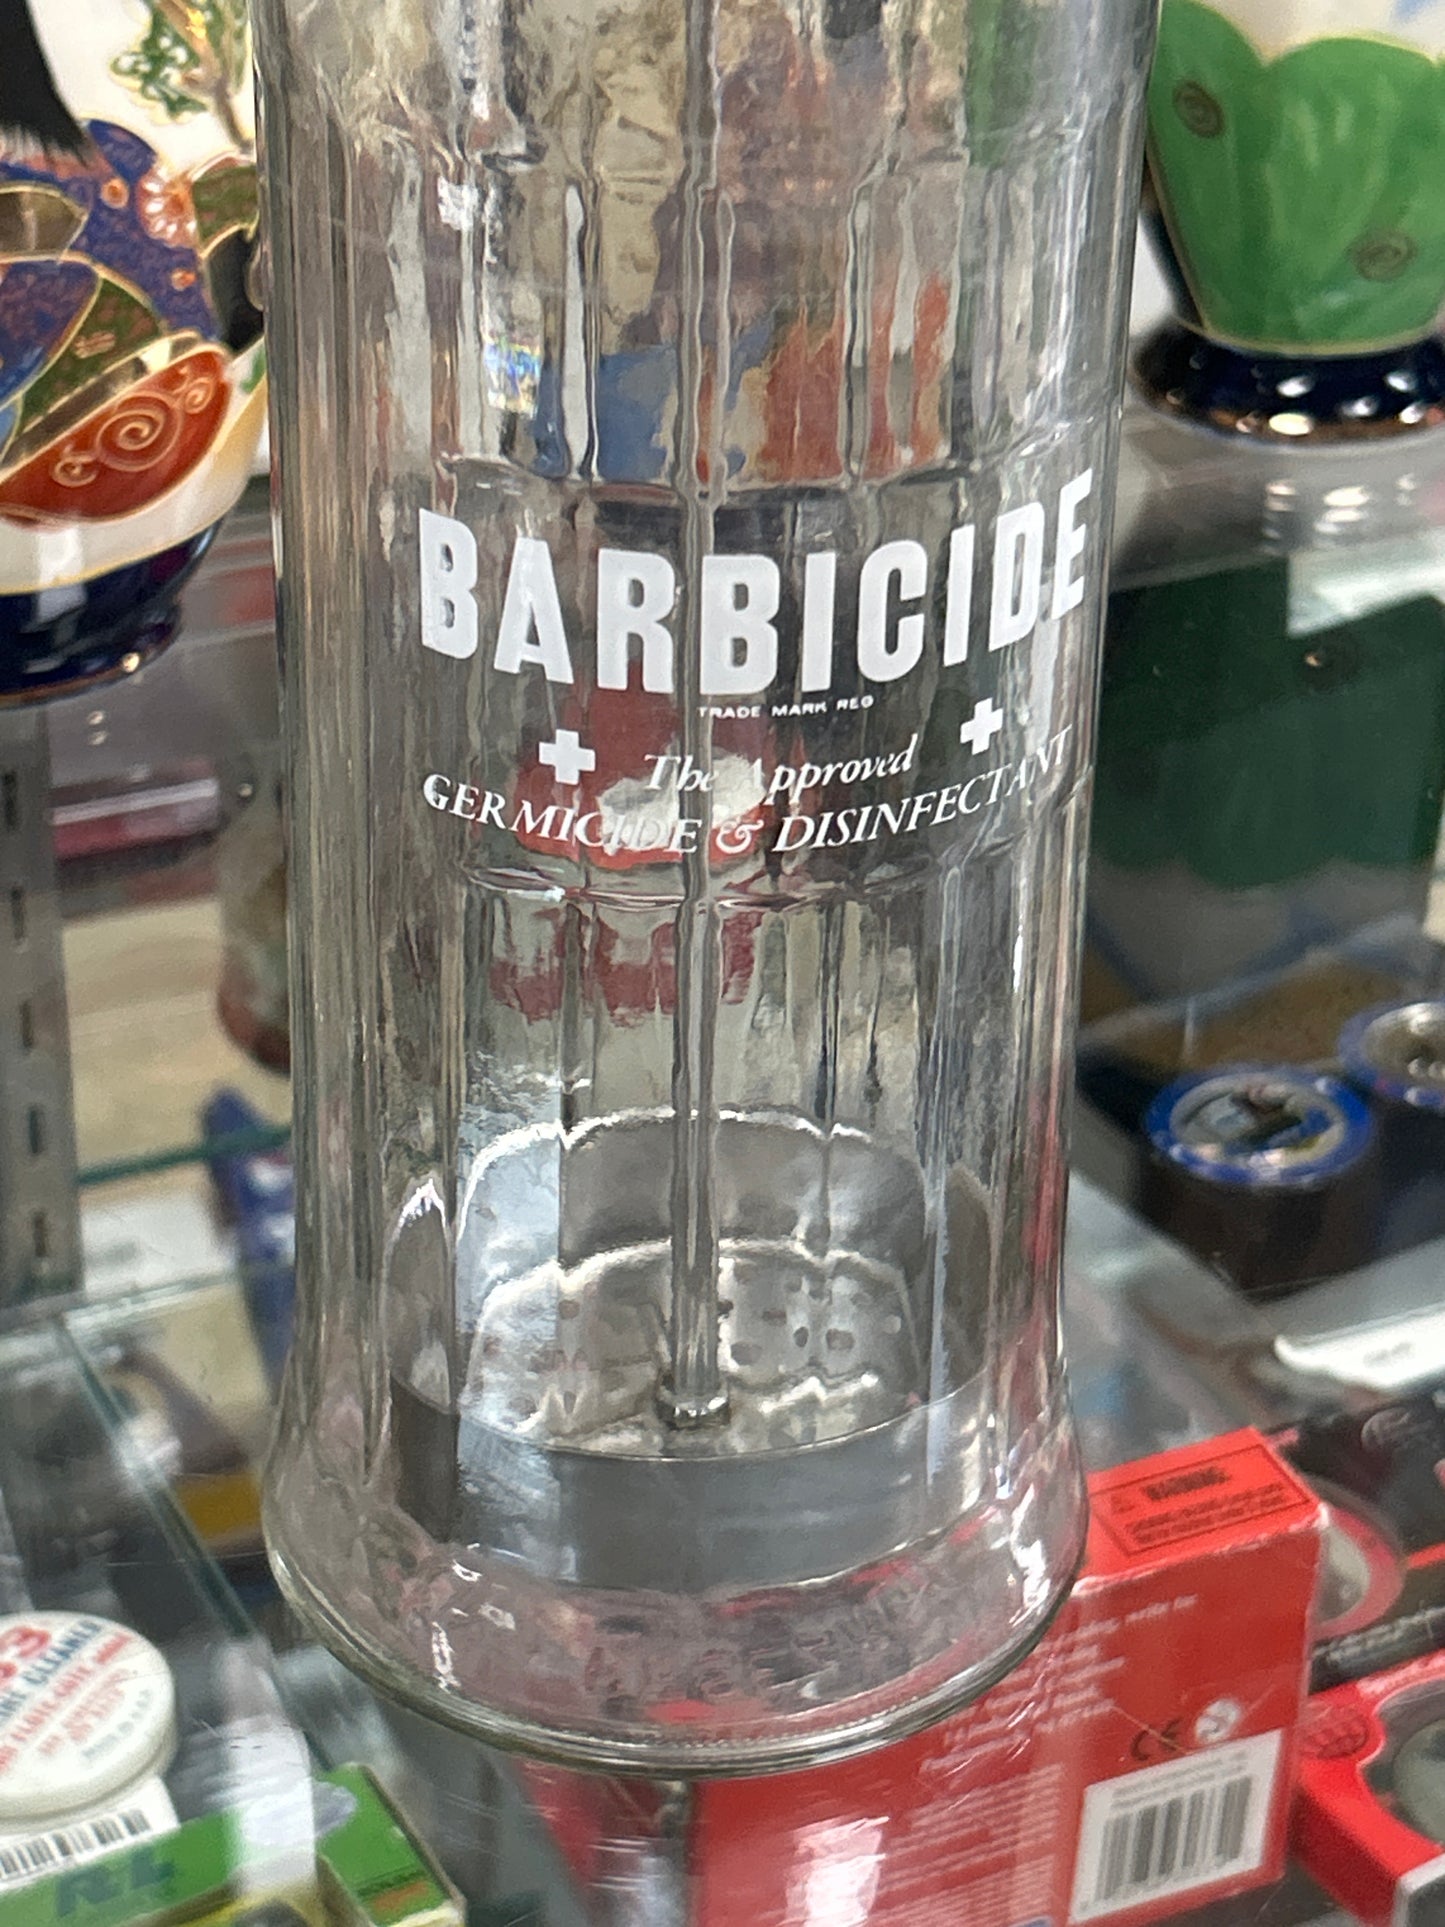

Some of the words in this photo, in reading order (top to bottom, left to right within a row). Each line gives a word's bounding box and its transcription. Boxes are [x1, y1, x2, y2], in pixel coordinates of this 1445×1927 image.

[419, 468, 1093, 696] BARBICIDE
[698, 706, 760, 719] TRADE
[771, 701, 828, 717] MARK
[836, 694, 875, 712] REG
[422, 773, 703, 854] GERMICIDE
[715, 817, 765, 854] &
[771, 723, 1073, 852] DISINFECTANT
[643, 753, 719, 792] The
